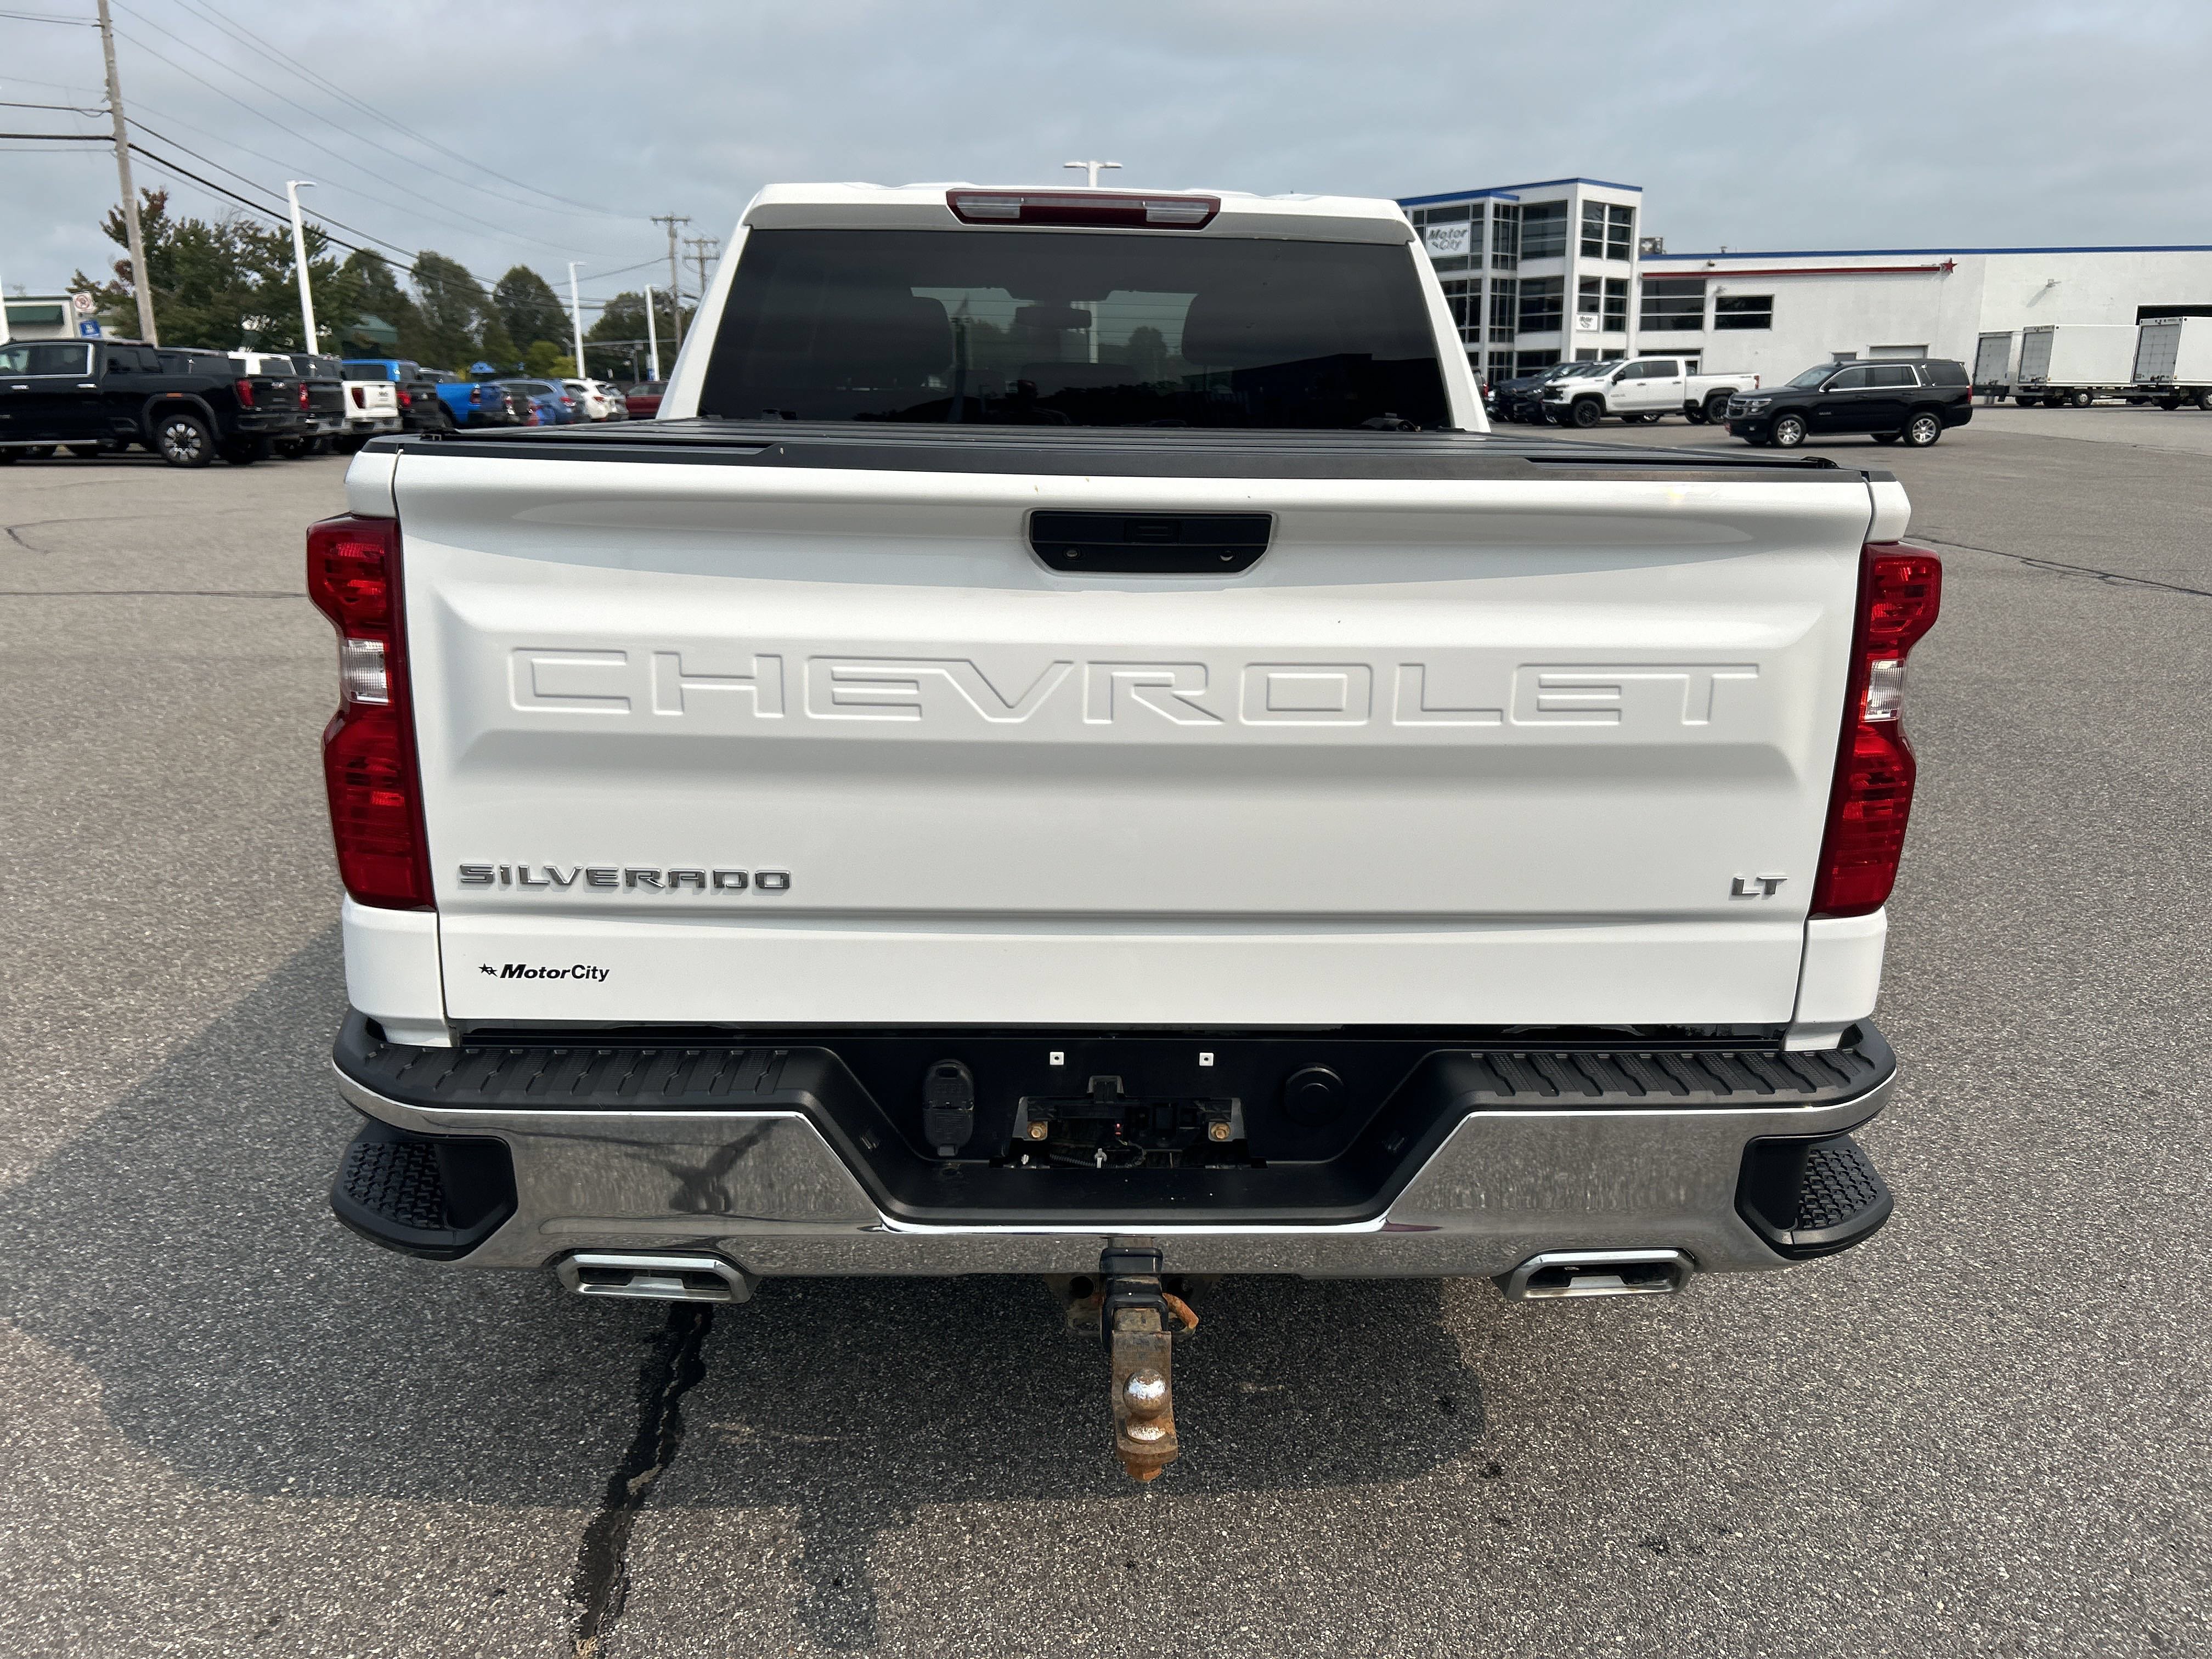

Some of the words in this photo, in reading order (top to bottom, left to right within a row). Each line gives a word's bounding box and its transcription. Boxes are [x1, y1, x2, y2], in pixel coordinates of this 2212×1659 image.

[508, 648, 1760, 726] CHEVROLET
[460, 864, 791, 889] SILVERADO
[1731, 876, 1788, 895] LT
[500, 964, 610, 982] MotorCity
